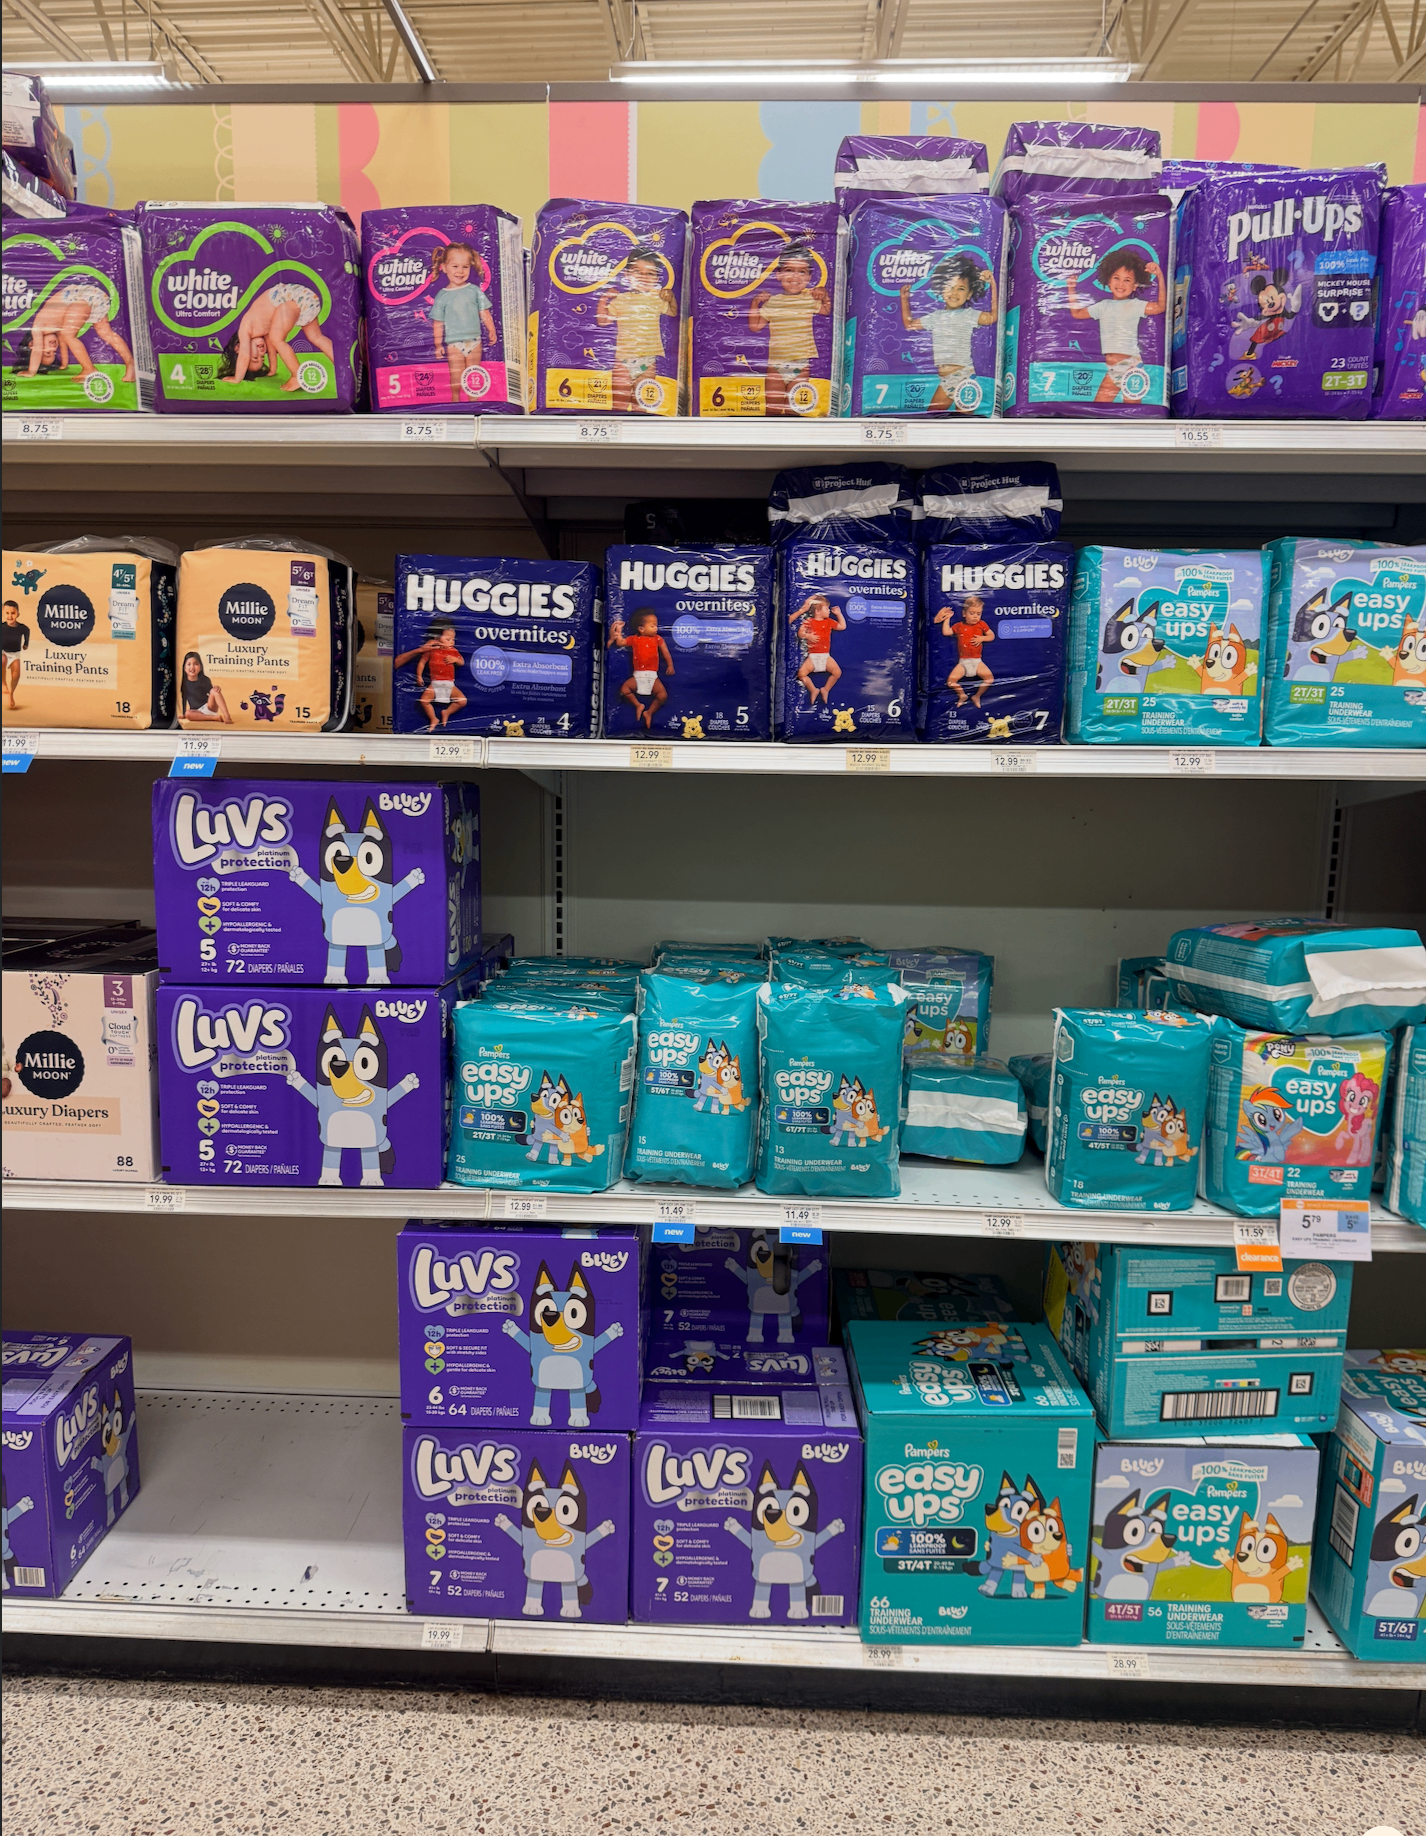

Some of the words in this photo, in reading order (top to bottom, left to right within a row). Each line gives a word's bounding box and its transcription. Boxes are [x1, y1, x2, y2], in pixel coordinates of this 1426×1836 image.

[1046, 240, 1092, 256] white
[712, 253, 758, 265] white
[1049, 254, 1096, 268] cloud
[1319, 260, 1344, 269] 100%
[378, 261, 423, 275] white
[715, 265, 762, 279] cloud
[882, 263, 931, 278] cloud
[168, 269, 231, 291] white
[381, 270, 426, 286] cloud
[174, 289, 238, 310] cloud
[1318, 289, 1363, 297] SURPRISE
[1331, 358, 1345, 369] 23
[170, 364, 186, 383] 4
[388, 374, 401, 394] 5
[559, 378, 572, 396] 6
[877, 384, 890, 403] 7
[1182, 432, 1208, 440] 10.55
[824, 479, 856, 488] Project
[858, 478, 872, 486] Hug
[807, 553, 906, 579] HUGGIES
[1124, 555, 1158, 571] BLUEY
[621, 561, 754, 592] HUGGIES
[942, 563, 1065, 592] HUGGIES
[406, 574, 574, 619] HUGGIES
[849, 585, 903, 596] overnites
[1187, 587, 1220, 598] Pampers
[225, 602, 268, 615] Millie
[676, 599, 749, 613] overnites
[1354, 592, 1411, 612] easy
[45, 605, 87, 620] Millie
[995, 604, 1056, 617] overnites
[1161, 602, 1214, 622] easy
[1358, 611, 1403, 630] ups
[475, 625, 568, 643] overnites
[1166, 621, 1207, 641] ups
[45, 649, 87, 663] Luxury
[24, 661, 72, 675] Training
[75, 663, 108, 675] Pants
[476, 660, 504, 670] 100%
[532, 662, 568, 671] Absorbent
[116, 702, 130, 713] 18
[888, 699, 901, 717] 6
[1107, 700, 1136, 709] 2T/3T
[1143, 697, 1155, 706] 25
[296, 707, 310, 717] 15
[736, 706, 749, 724] 5
[184, 741, 208, 750] 11.99
[436, 746, 459, 755] 12.99
[852, 754, 876, 762] 12.99
[1175, 757, 1200, 766] 12.99
[183, 762, 204, 770] new
[379, 792, 432, 816] BLUEY
[257, 850, 290, 858] platinum
[221, 857, 291, 869] protection
[201, 883, 216, 892] 12h
[201, 939, 216, 961] 5
[226, 961, 245, 973] 72
[248, 964, 273, 973] DIAPERS
[277, 962, 304, 973] PAÑALES
[113, 981, 124, 995] 3
[649, 1032, 699, 1053] easy
[479, 1047, 510, 1060] Pampers
[1266, 1043, 1295, 1057] PONY
[25, 1053, 75, 1069] Millie
[651, 1047, 688, 1067] ups
[462, 1064, 530, 1090] easy
[776, 1071, 832, 1090] easy
[467, 1084, 516, 1108] ups
[1286, 1079, 1337, 1100] easy
[780, 1086, 822, 1107] ups
[52, 1105, 109, 1119] Diapers
[1296, 1098, 1336, 1117] ups
[473, 1132, 495, 1140] 2T/3T
[117, 1157, 133, 1166] 88
[456, 1167, 482, 1175] TRAINING
[484, 1169, 520, 1178] UNDERWEAR
[1252, 1169, 1281, 1179] 3T/4T
[1288, 1168, 1300, 1177] 22
[150, 1195, 172, 1204] 19.99
[510, 1202, 530, 1210] 12.99
[660, 1207, 683, 1215] 11.49
[665, 1228, 683, 1236] new
[1240, 1229, 1263, 1238] 11.59
[581, 1251, 628, 1272] BLUEY
[1241, 1252, 1279, 1264] clearance
[454, 1302, 516, 1313] protection
[429, 1386, 443, 1404] 6
[449, 1404, 467, 1416] 64
[802, 1443, 849, 1463] BLUEY
[905, 1444, 949, 1459] Pampers
[1121, 1458, 1164, 1477] BLUEY
[1201, 1465, 1228, 1475] 100%
[878, 1465, 981, 1494] easy
[1207, 1486, 1247, 1499] Pampers
[685, 1497, 747, 1507] protection
[888, 1494, 961, 1524] ups
[1173, 1504, 1240, 1525] easy
[910, 1533, 945, 1543] 100%
[1178, 1524, 1230, 1546] ups
[898, 1560, 932, 1570] 3T/4T
[430, 1571, 442, 1586] 7
[448, 1586, 462, 1596] 52
[870, 1596, 889, 1608] 66
[870, 1609, 910, 1617] TRAINING
[1108, 1605, 1141, 1614] 4T/5T
[1148, 1607, 1162, 1616] 56
[1168, 1604, 1211, 1613] TRAINING
[869, 1617, 923, 1625] UNDERWEAR
[1168, 1612, 1224, 1622] UNDERWEAR
[869, 1625, 921, 1635] SOUS-VÊTEMENTS
[922, 1625, 972, 1635] D'ENTRAÎNEMENT
[1167, 1621, 1222, 1631] SOUS-VÊTEMENTS
[1380, 1623, 1415, 1633] 5T/6T
[429, 1631, 450, 1639] 19.99
[1166, 1630, 1219, 1640] D'ENTRAÎNEMENT
[868, 1650, 891, 1659] 28.99
[1114, 1660, 1137, 1668] 28.99
